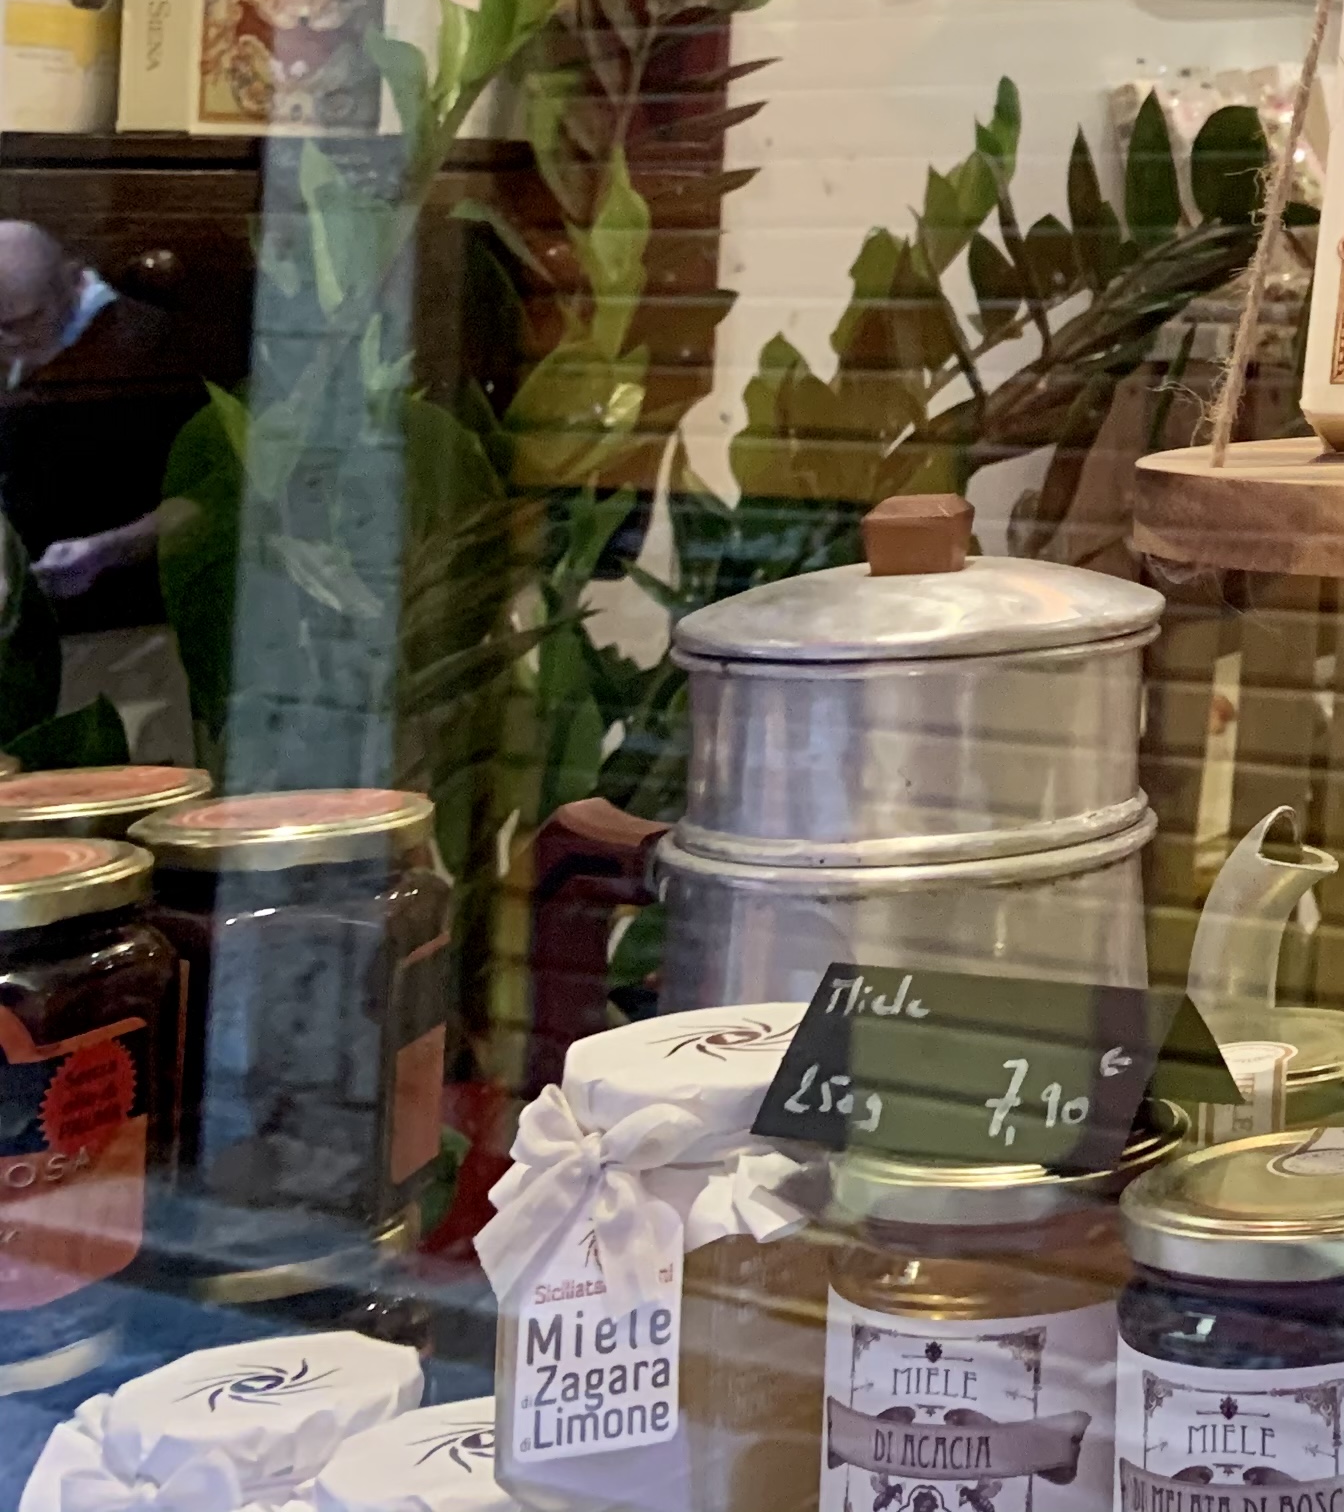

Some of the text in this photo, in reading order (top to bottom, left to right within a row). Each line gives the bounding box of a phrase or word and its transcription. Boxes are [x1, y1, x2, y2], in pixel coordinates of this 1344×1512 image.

[826, 974, 931, 1018] Miele
[526, 1308, 672, 1366] Miele
[534, 1357, 671, 1412] Zagara
[891, 1366, 978, 1401] MIELE
[533, 1400, 670, 1450] Limone
[1187, 1423, 1277, 1459] MIELE
[873, 1428, 993, 1470] DI ACACIA
